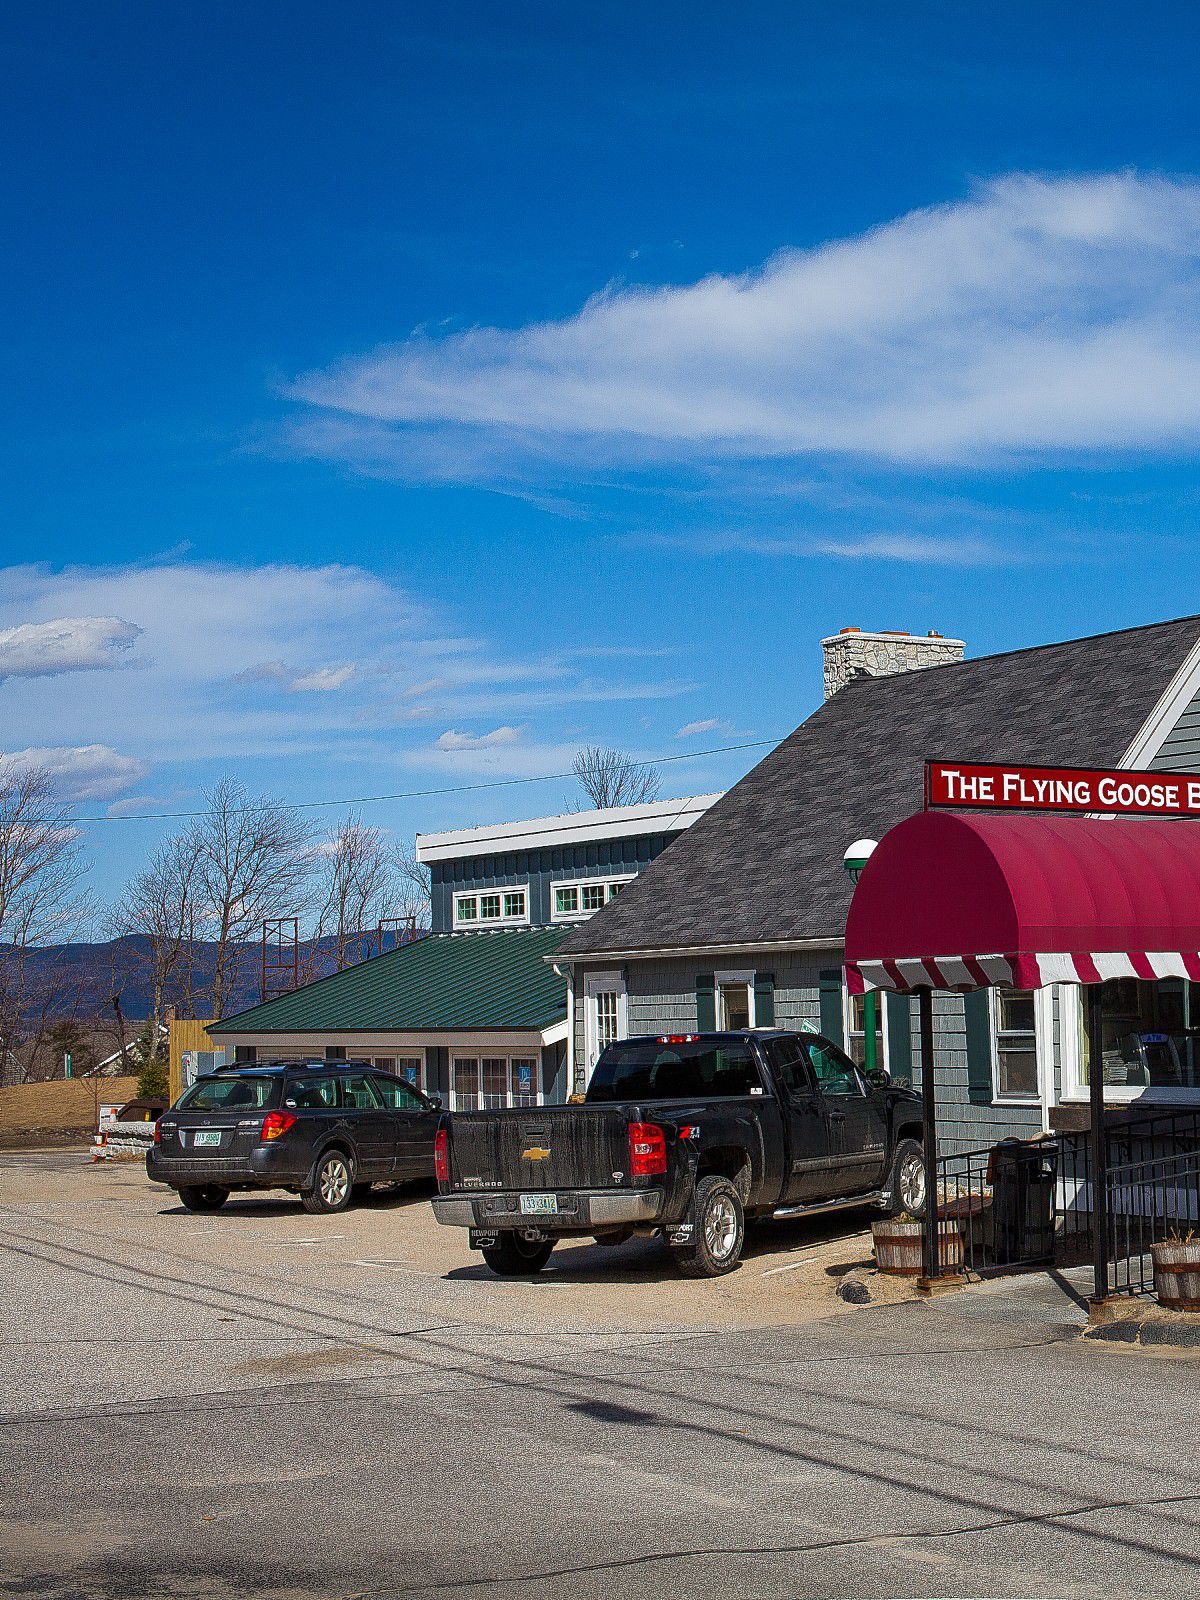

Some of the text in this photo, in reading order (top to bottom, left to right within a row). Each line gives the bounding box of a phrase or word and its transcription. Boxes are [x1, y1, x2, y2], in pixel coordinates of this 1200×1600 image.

[941, 769, 995, 801] THE
[1002, 773, 1091, 804] FLYING
[1098, 777, 1179, 808] GOOSE
[666, 1223, 694, 1232] NEWPORT
[471, 1229, 500, 1237] NEWPORT
